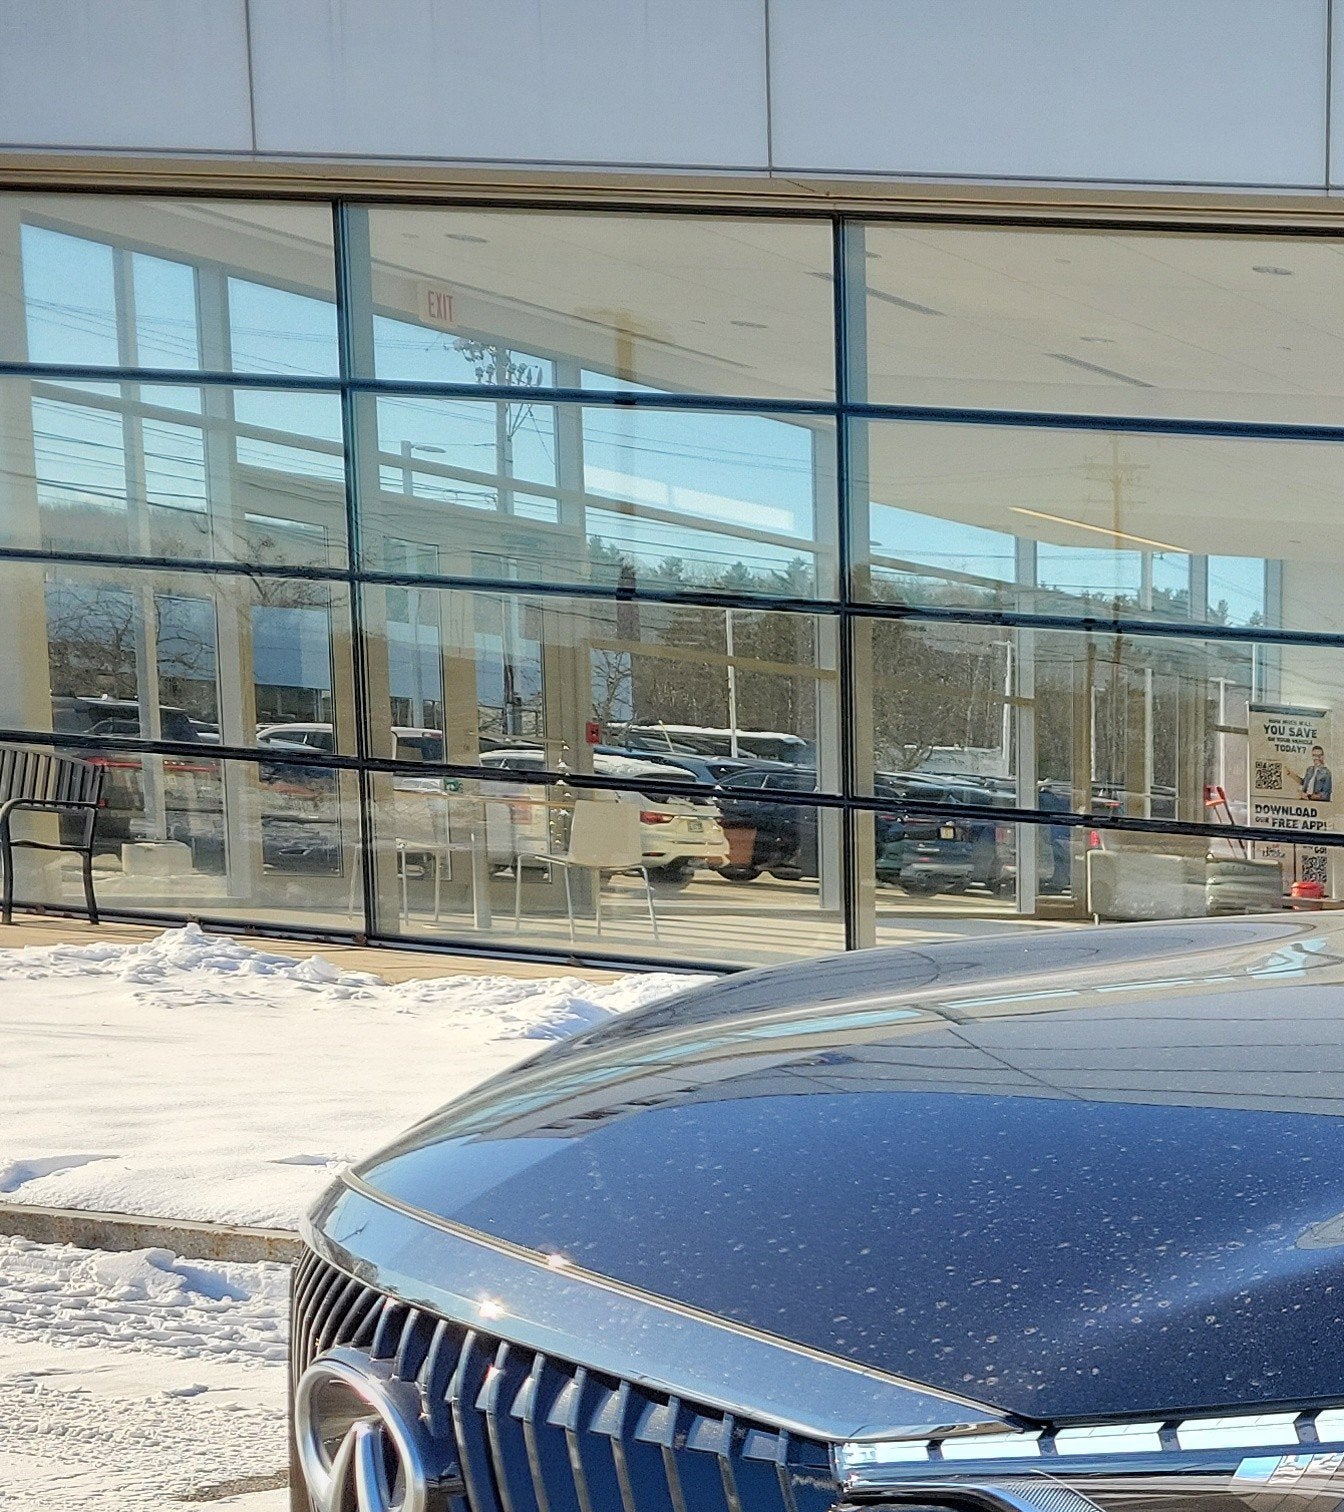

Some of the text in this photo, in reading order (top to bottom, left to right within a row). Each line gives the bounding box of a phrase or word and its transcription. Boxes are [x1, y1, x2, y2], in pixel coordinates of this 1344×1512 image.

[428, 290, 453, 322] EXIT
[1263, 724, 1318, 739] YOU SAVE
[1275, 744, 1307, 754] TODAY?
[1254, 804, 1318, 818] DOWNLOAD
[1271, 818, 1299, 829] FREE
[1301, 820, 1328, 831] APP!
